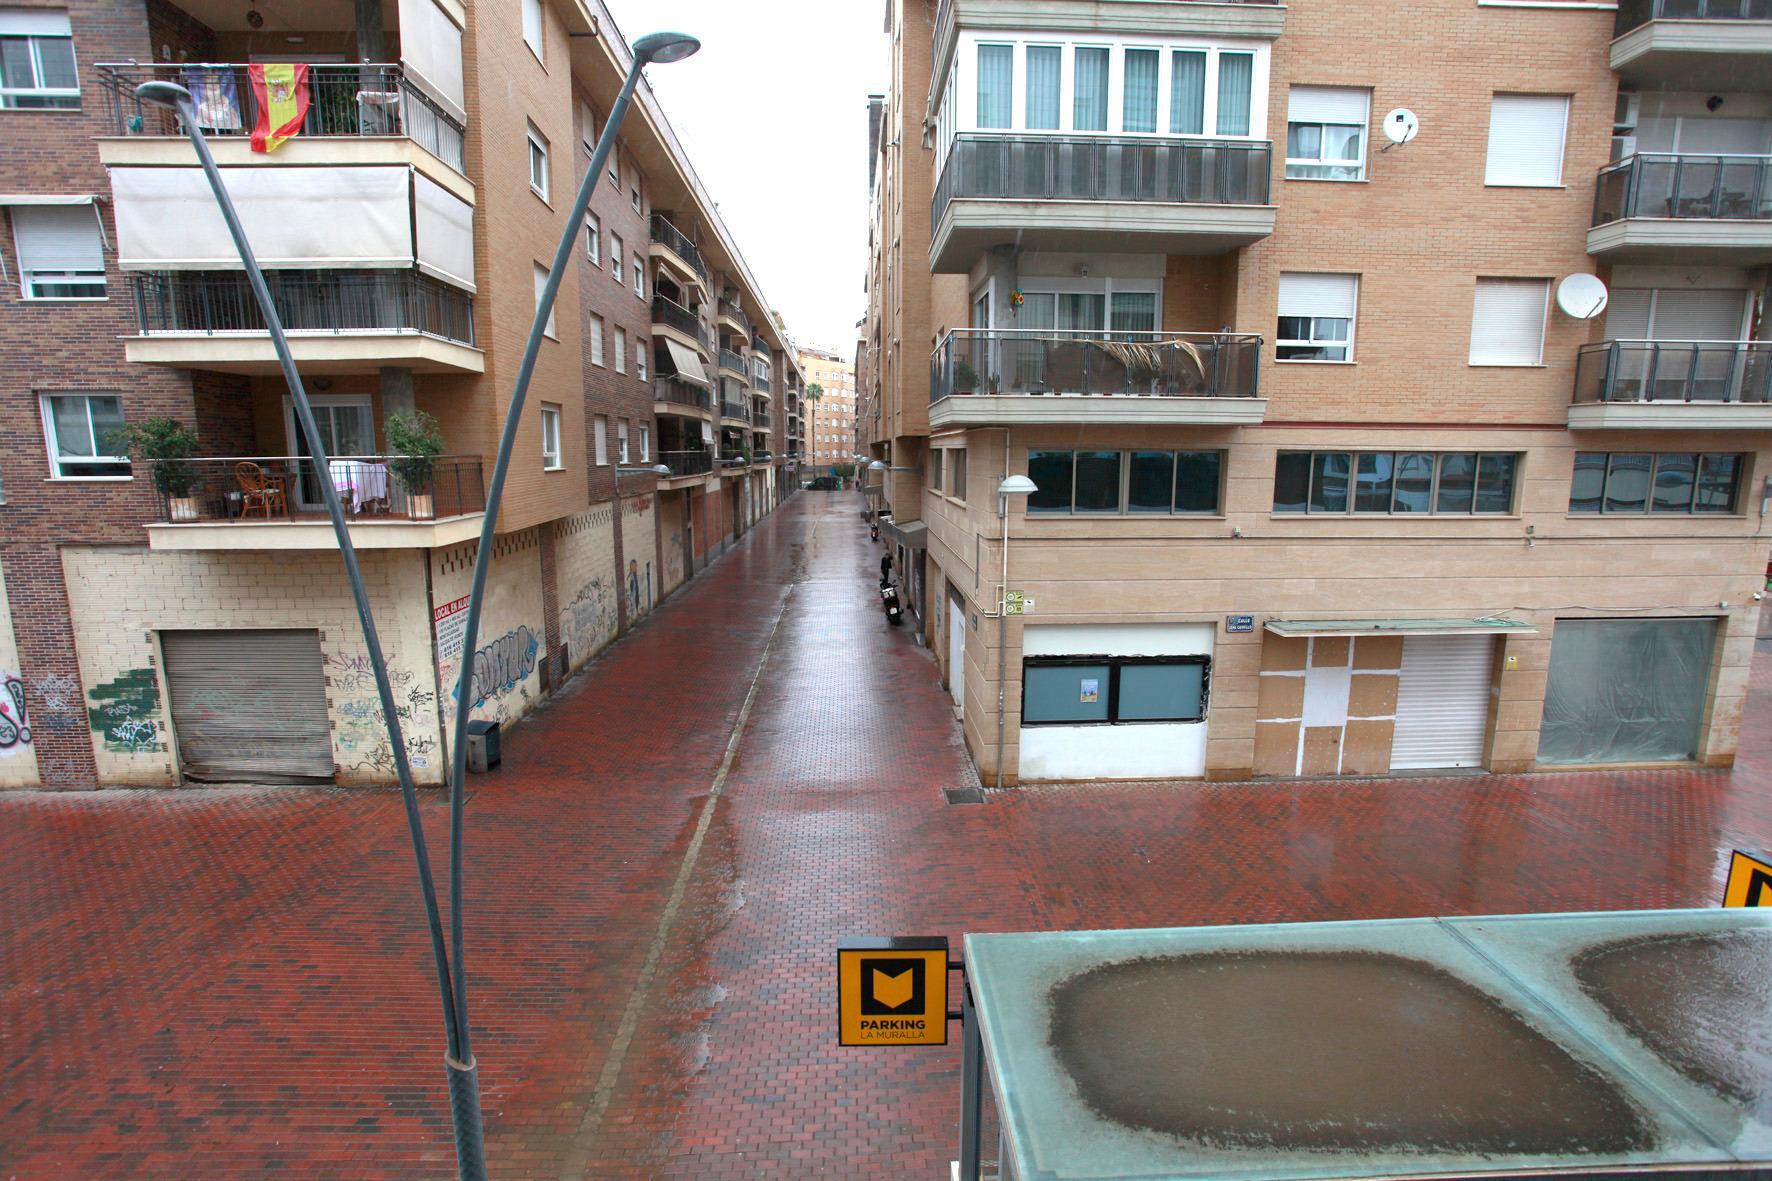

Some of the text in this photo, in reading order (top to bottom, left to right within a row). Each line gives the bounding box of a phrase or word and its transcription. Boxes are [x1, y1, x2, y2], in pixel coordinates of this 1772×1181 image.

[434, 605, 450, 620] LOCAL
[450, 601, 458, 613] EN
[861, 1020, 925, 1029] PARKING
[861, 1031, 925, 1039] LA MURALLA
